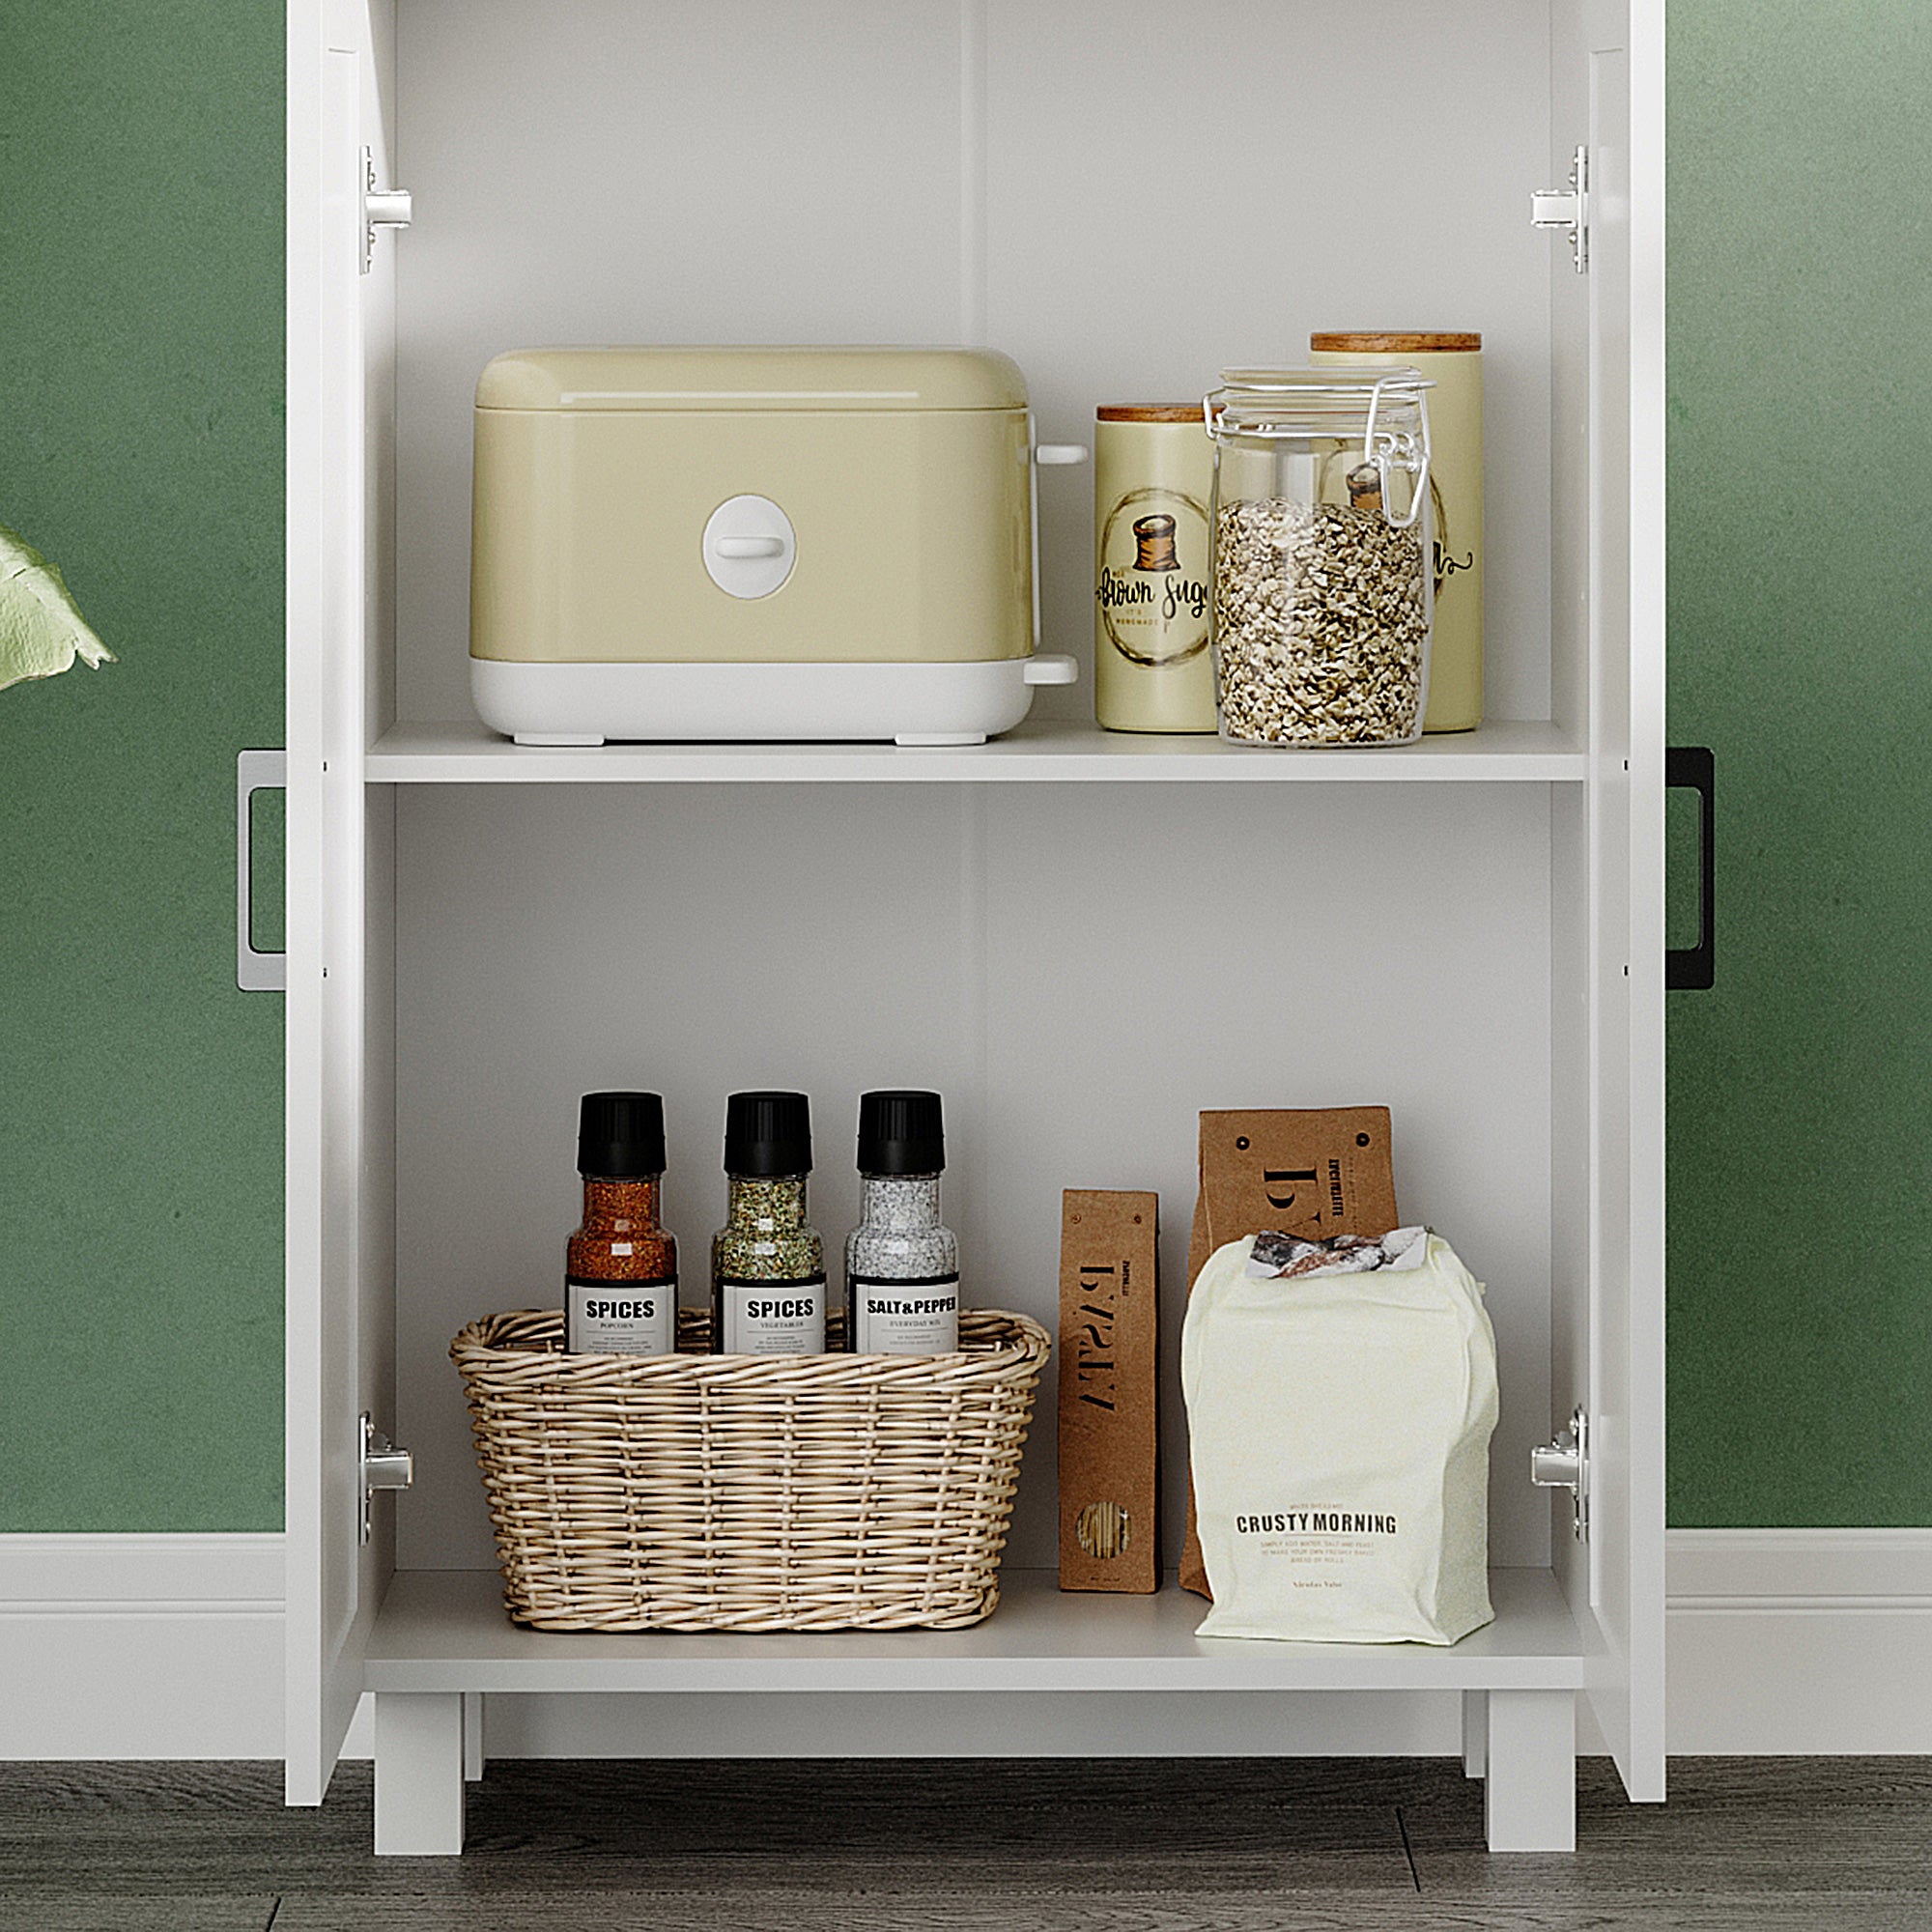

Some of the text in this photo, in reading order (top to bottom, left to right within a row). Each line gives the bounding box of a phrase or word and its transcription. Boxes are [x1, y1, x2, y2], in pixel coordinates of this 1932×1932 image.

[585, 1299, 655, 1320] SPICES
[747, 1298, 814, 1319] SPICES
[1236, 1513, 1397, 1535] CRUSTY MORNING
